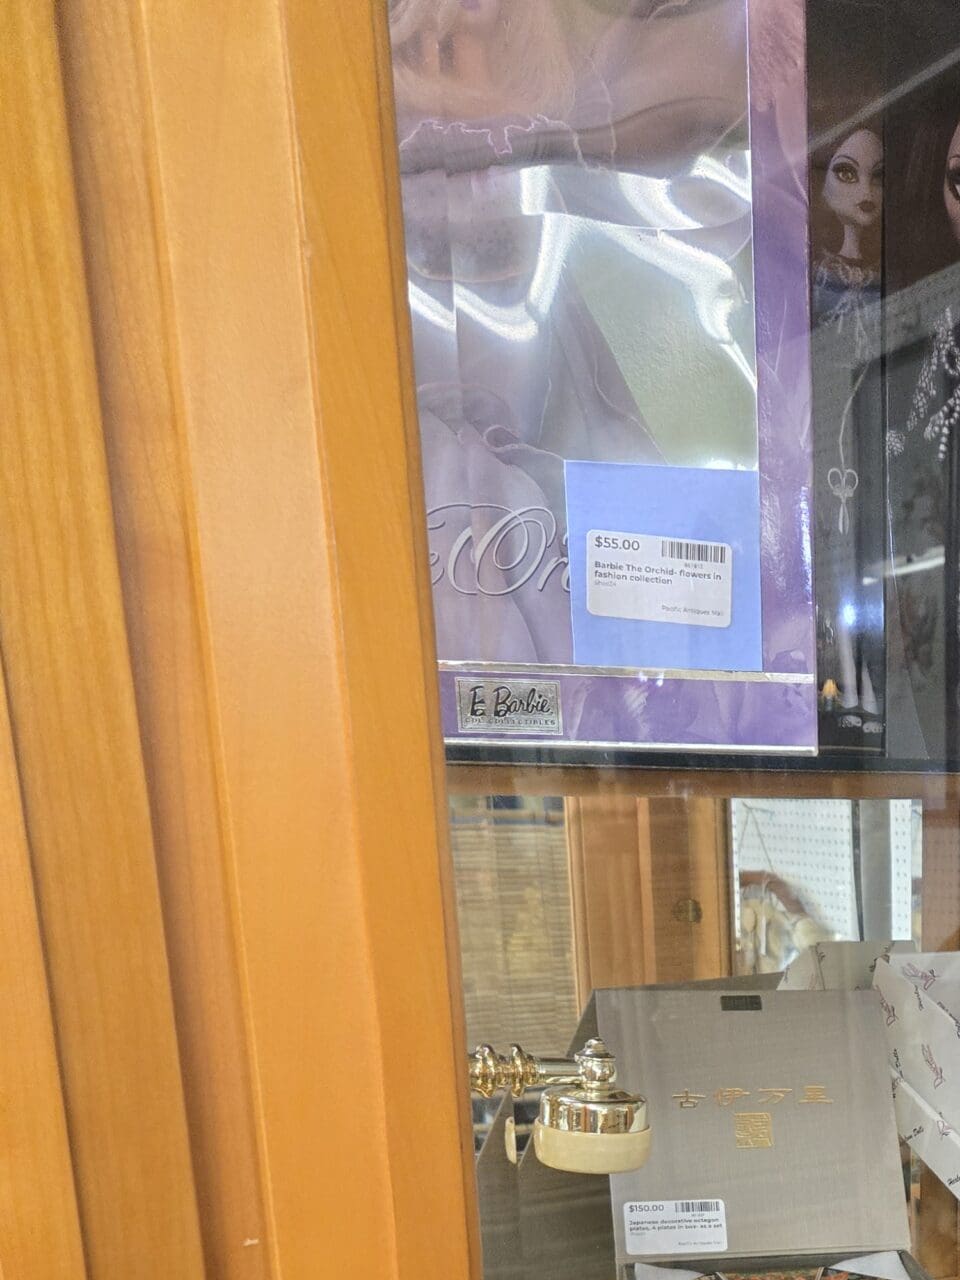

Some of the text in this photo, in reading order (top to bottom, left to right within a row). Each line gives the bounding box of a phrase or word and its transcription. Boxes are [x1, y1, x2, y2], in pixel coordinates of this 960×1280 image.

[594, 535, 640, 551] $55.00
[594, 561, 624, 571] Barbie
[626, 563, 642, 573] The
[679, 568, 711, 580] flowers
[594, 570, 628, 581] fashion
[630, 574, 673, 585] collection
[629, 1204, 664, 1213] $150.00
